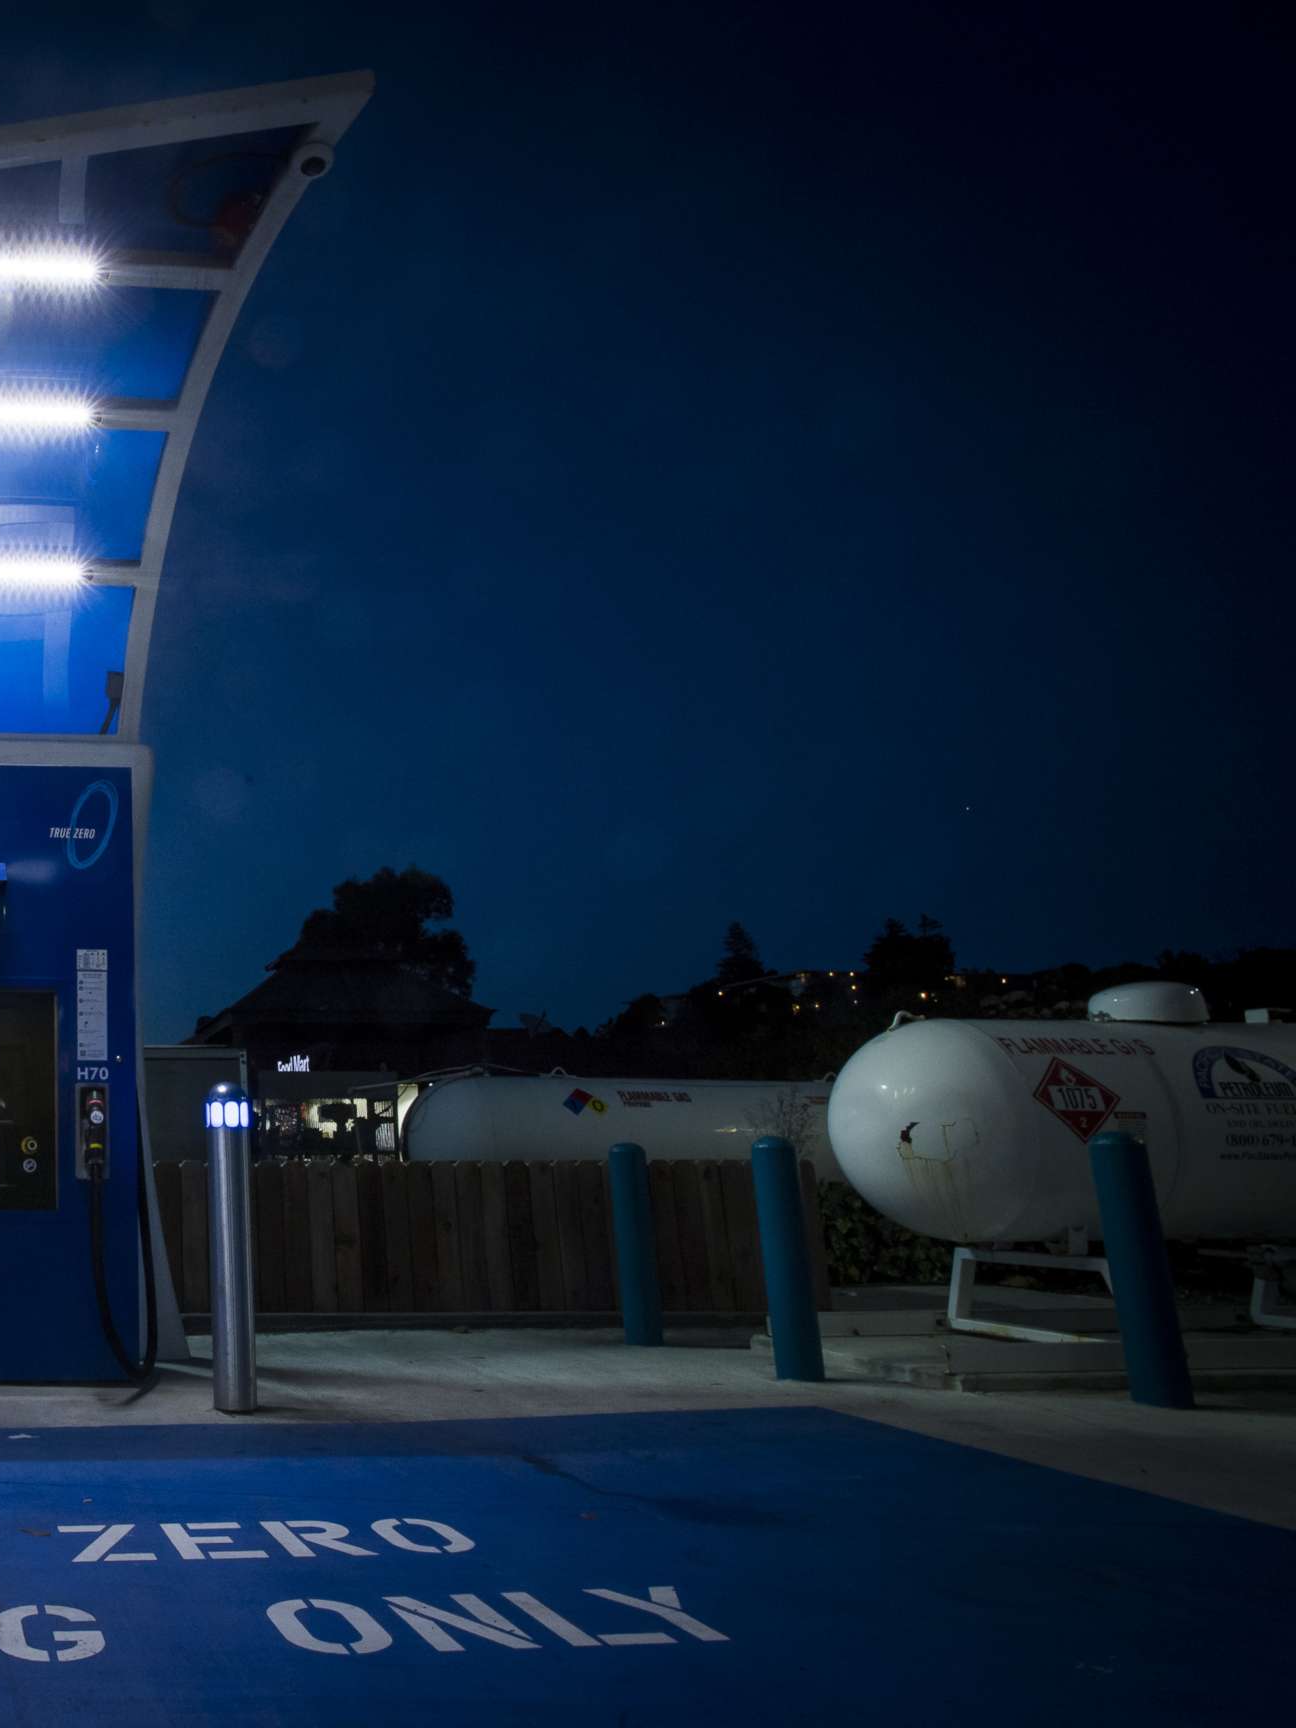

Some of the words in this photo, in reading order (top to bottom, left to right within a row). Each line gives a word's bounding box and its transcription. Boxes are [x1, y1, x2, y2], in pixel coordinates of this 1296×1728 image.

[49, 827, 71, 839] TRUE
[73, 827, 96, 840] ZERO
[996, 1037, 1115, 1055] FLAMMABLE
[77, 1067, 109, 1081] H70
[1218, 1081, 1294, 1097] PETROLEUM
[1059, 1087, 1097, 1110] 1075
[1205, 1103, 1260, 1115] ON-SITE
[1078, 1117, 1089, 1128] 2
[1225, 1133, 1260, 1147] (800)
[57, 1517, 476, 1564] ZERO
[266, 1585, 730, 1656] ONLY
